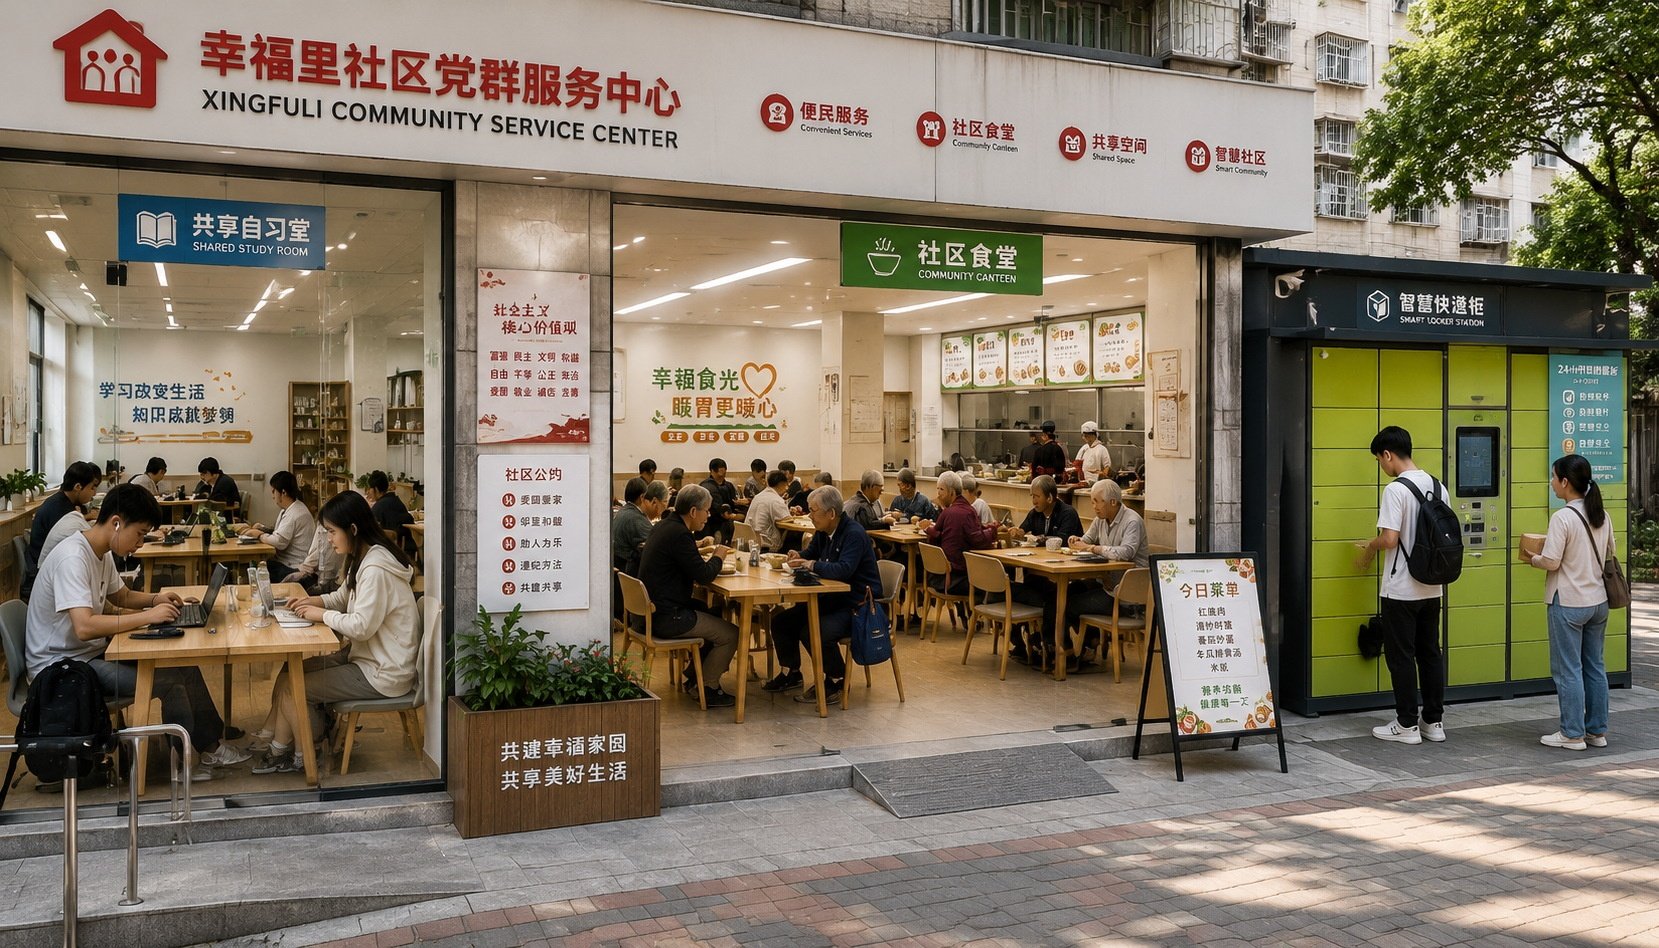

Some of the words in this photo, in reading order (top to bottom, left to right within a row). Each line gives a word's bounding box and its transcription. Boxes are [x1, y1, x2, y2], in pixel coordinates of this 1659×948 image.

[200, 29, 682, 117] 幸福里社区党群服务中心
[202, 89, 322, 119] XINGFULI
[332, 101, 483, 131] COMMUNITY
[491, 115, 584, 140] SERVICE
[593, 124, 678, 148] CENTER
[800, 101, 869, 126] 便民服务
[843, 127, 873, 138] Services
[952, 118, 1015, 141] 社区食堂
[1092, 133, 1147, 155] 共享空间
[192, 212, 310, 243] 共享自习堂
[193, 241, 235, 253] SHARED
[238, 244, 274, 255] STUDY
[277, 246, 308, 256] ROOM
[918, 240, 1017, 270] 社区食堂
[918, 269, 974, 281] COMMUNITY
[976, 272, 1017, 283] CANTEEN
